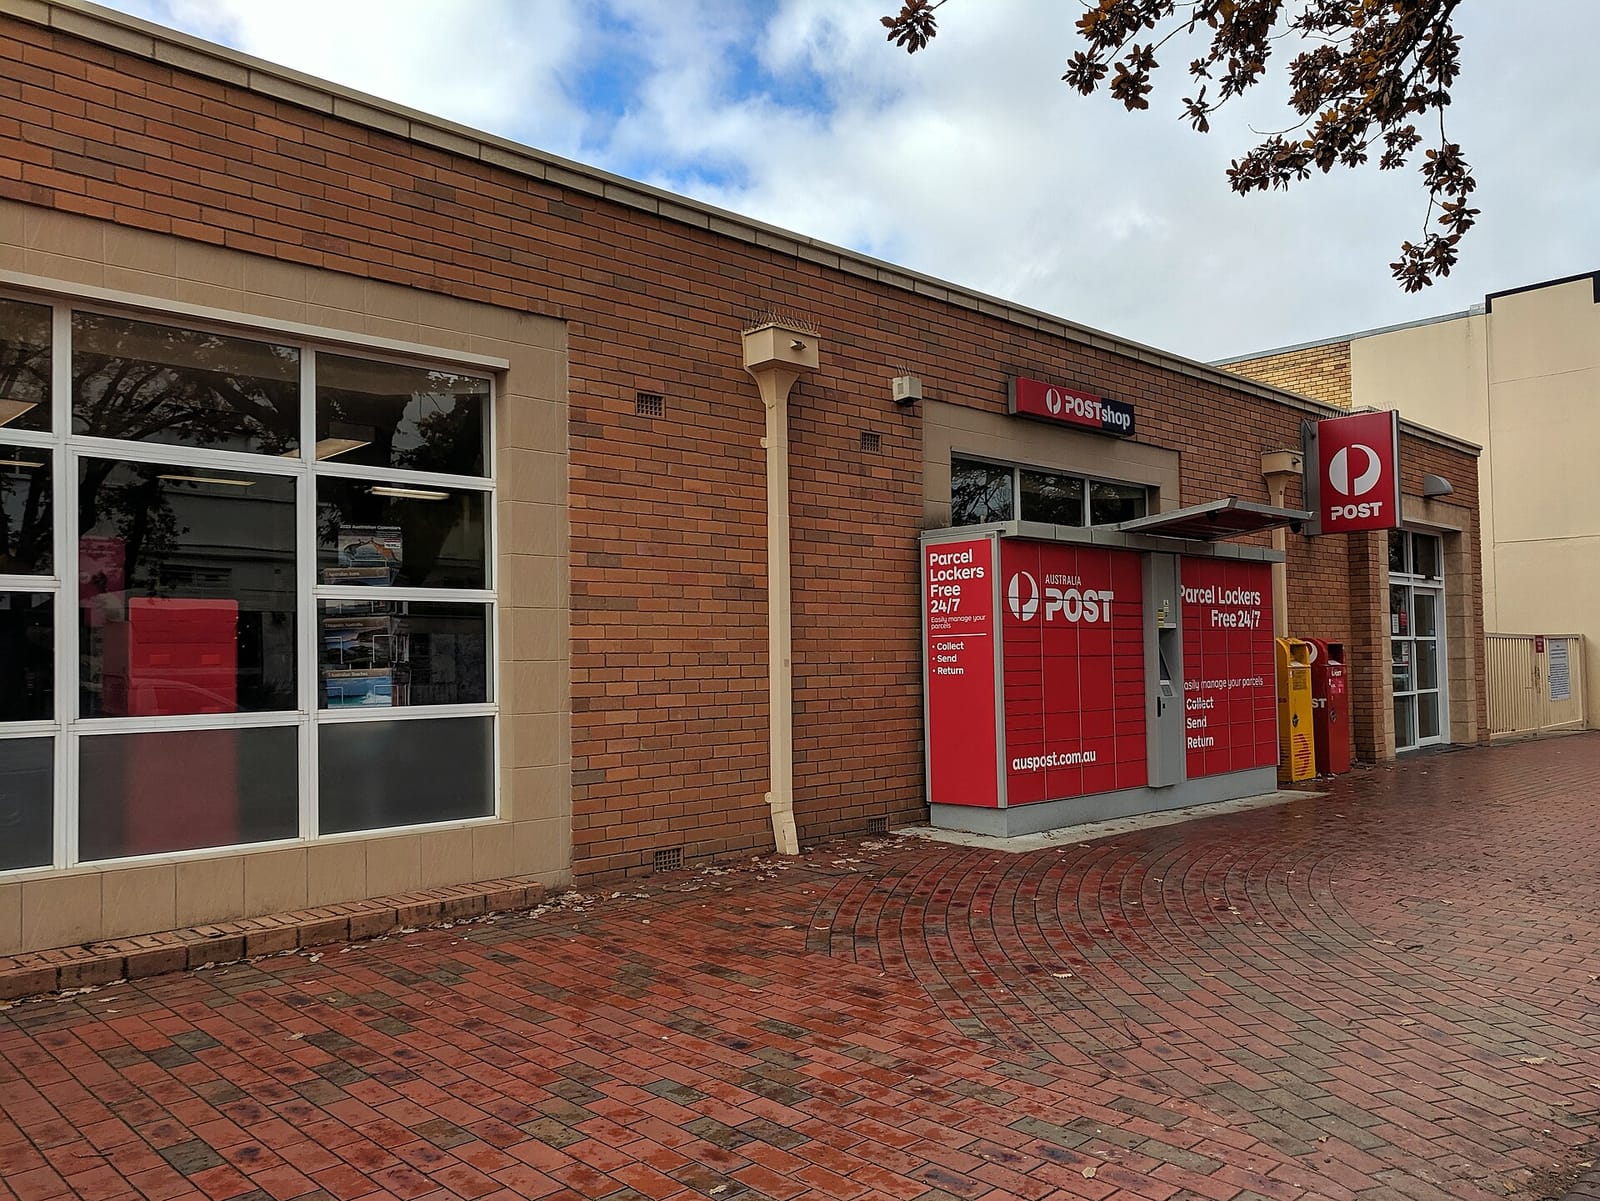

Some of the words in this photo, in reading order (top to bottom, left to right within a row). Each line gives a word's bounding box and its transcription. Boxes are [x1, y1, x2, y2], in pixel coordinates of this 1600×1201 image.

[1330, 501, 1383, 521] POST
[930, 548, 973, 566] Parcel
[930, 566, 985, 582] Lockers
[1045, 573, 1082, 586] AUSTRALIA
[930, 583, 961, 598] Free
[1218, 586, 1261, 606] Lockers
[930, 597, 960, 614] 24/7
[1045, 587, 1114, 623] POST
[930, 616, 948, 624] Easily
[948, 615, 972, 623] manage
[973, 615, 986, 623] your
[1211, 609, 1237, 628] Free
[1237, 609, 1261, 630] 24/7
[936, 641, 965, 651] Collect
[937, 653, 957, 663] Send
[937, 666, 964, 675] Return
[1183, 679, 1199, 691] asily
[1200, 679, 1227, 690] manage
[1227, 678, 1242, 689] your
[1242, 675, 1264, 688] parcels
[1186, 696, 1214, 710] Collect
[1186, 715, 1207, 729] Send
[1187, 735, 1214, 749] Return
[1012, 750, 1096, 772] auspost.com.au
